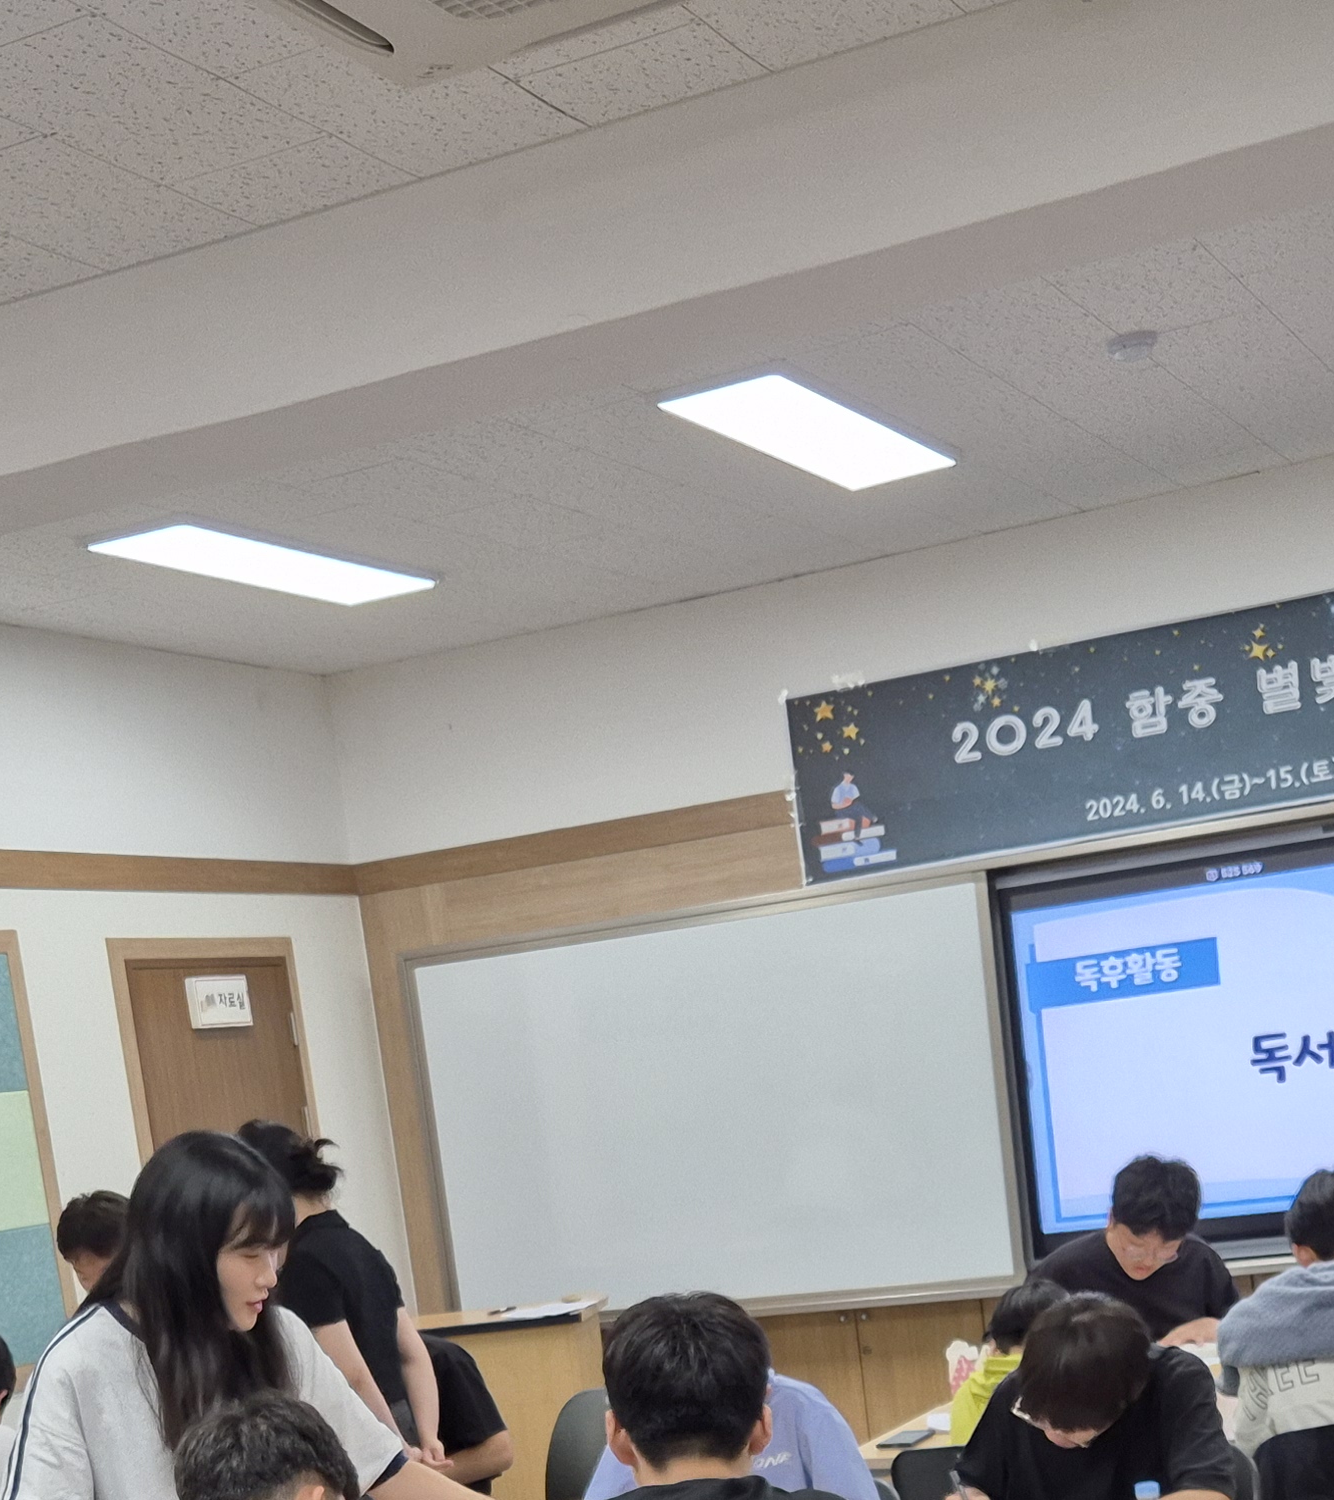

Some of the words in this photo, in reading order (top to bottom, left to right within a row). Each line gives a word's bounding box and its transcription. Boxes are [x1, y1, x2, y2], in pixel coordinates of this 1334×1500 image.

[951, 698, 1100, 764] 2024
[1125, 677, 1224, 739] 함중
[1085, 793, 1147, 821] 2024.
[1151, 788, 1172, 810] 6.
[1073, 946, 1181, 992] 독후활동
[217, 992, 246, 1010] 자료실
